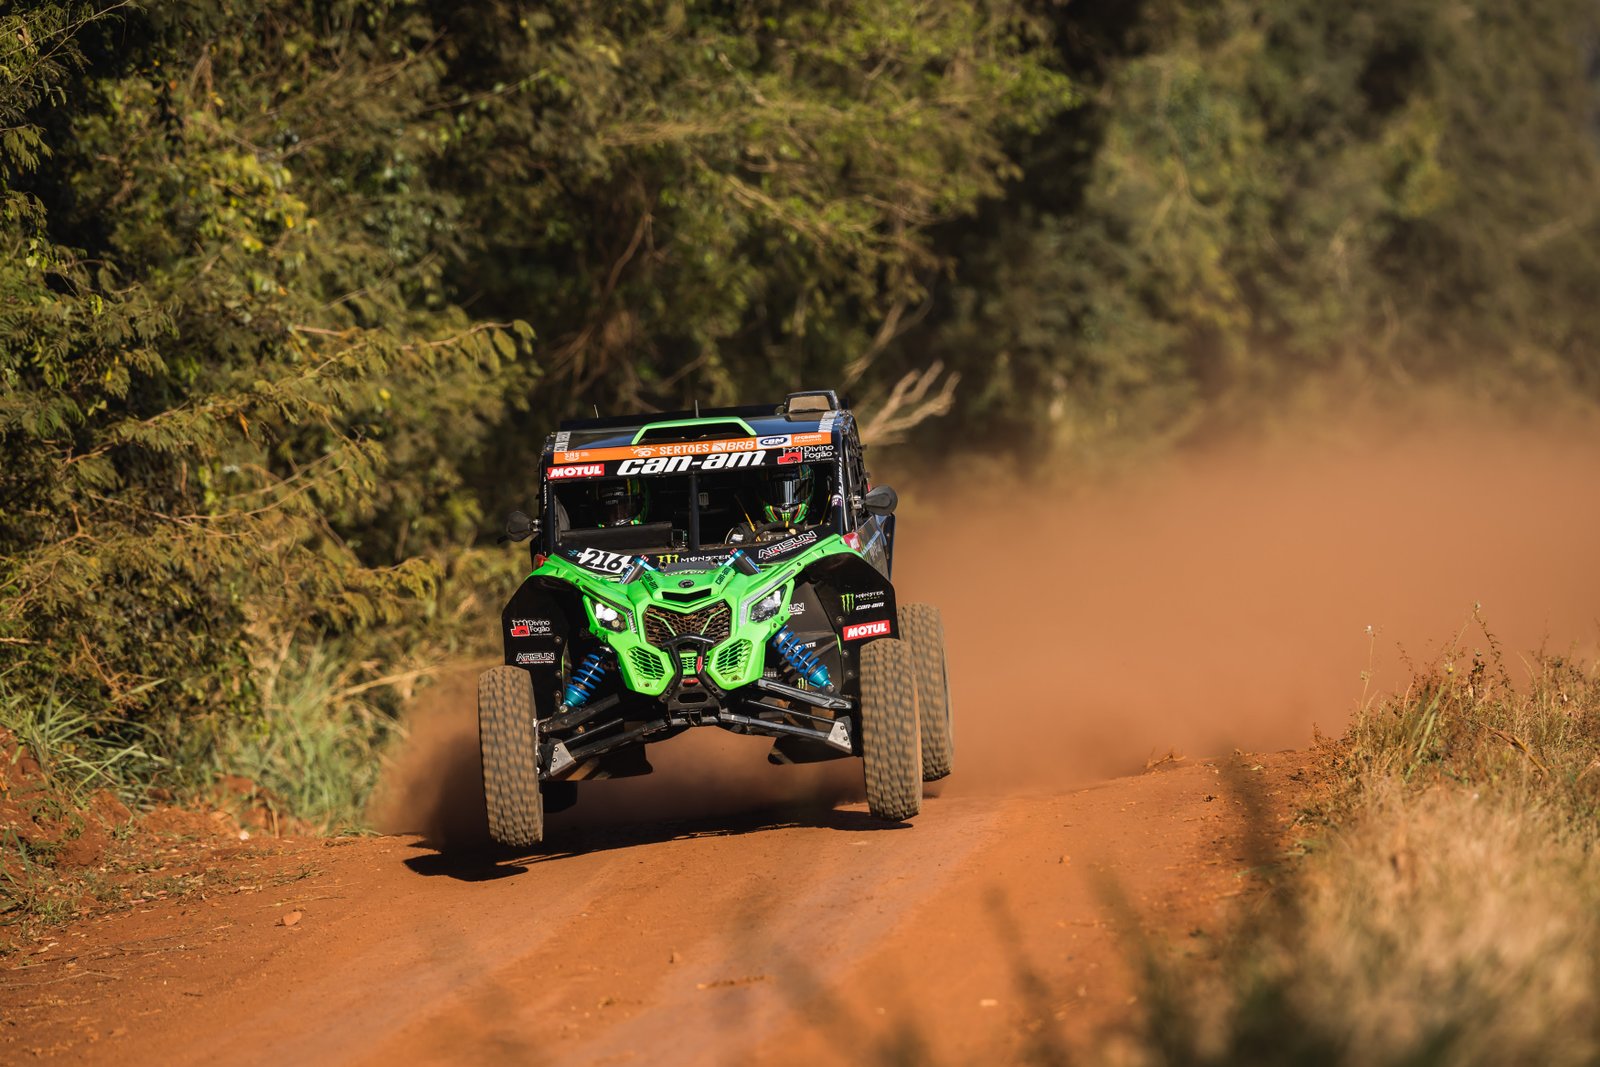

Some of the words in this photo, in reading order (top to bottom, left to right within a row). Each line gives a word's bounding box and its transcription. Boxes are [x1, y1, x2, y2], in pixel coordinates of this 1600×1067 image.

[659, 443, 710, 455] SERTÕES
[726, 440, 755, 451] BRB
[804, 445, 834, 453] Divino
[804, 451, 833, 460] Fogão
[616, 450, 766, 476] can-am
[549, 465, 603, 478] MOTUL
[758, 530, 818, 558] ARISUN
[582, 550, 625, 571] 216
[528, 619, 551, 627] Divino
[529, 625, 551, 634] Fogão
[847, 623, 887, 638] MOTUL
[515, 652, 556, 662] ARISUN
